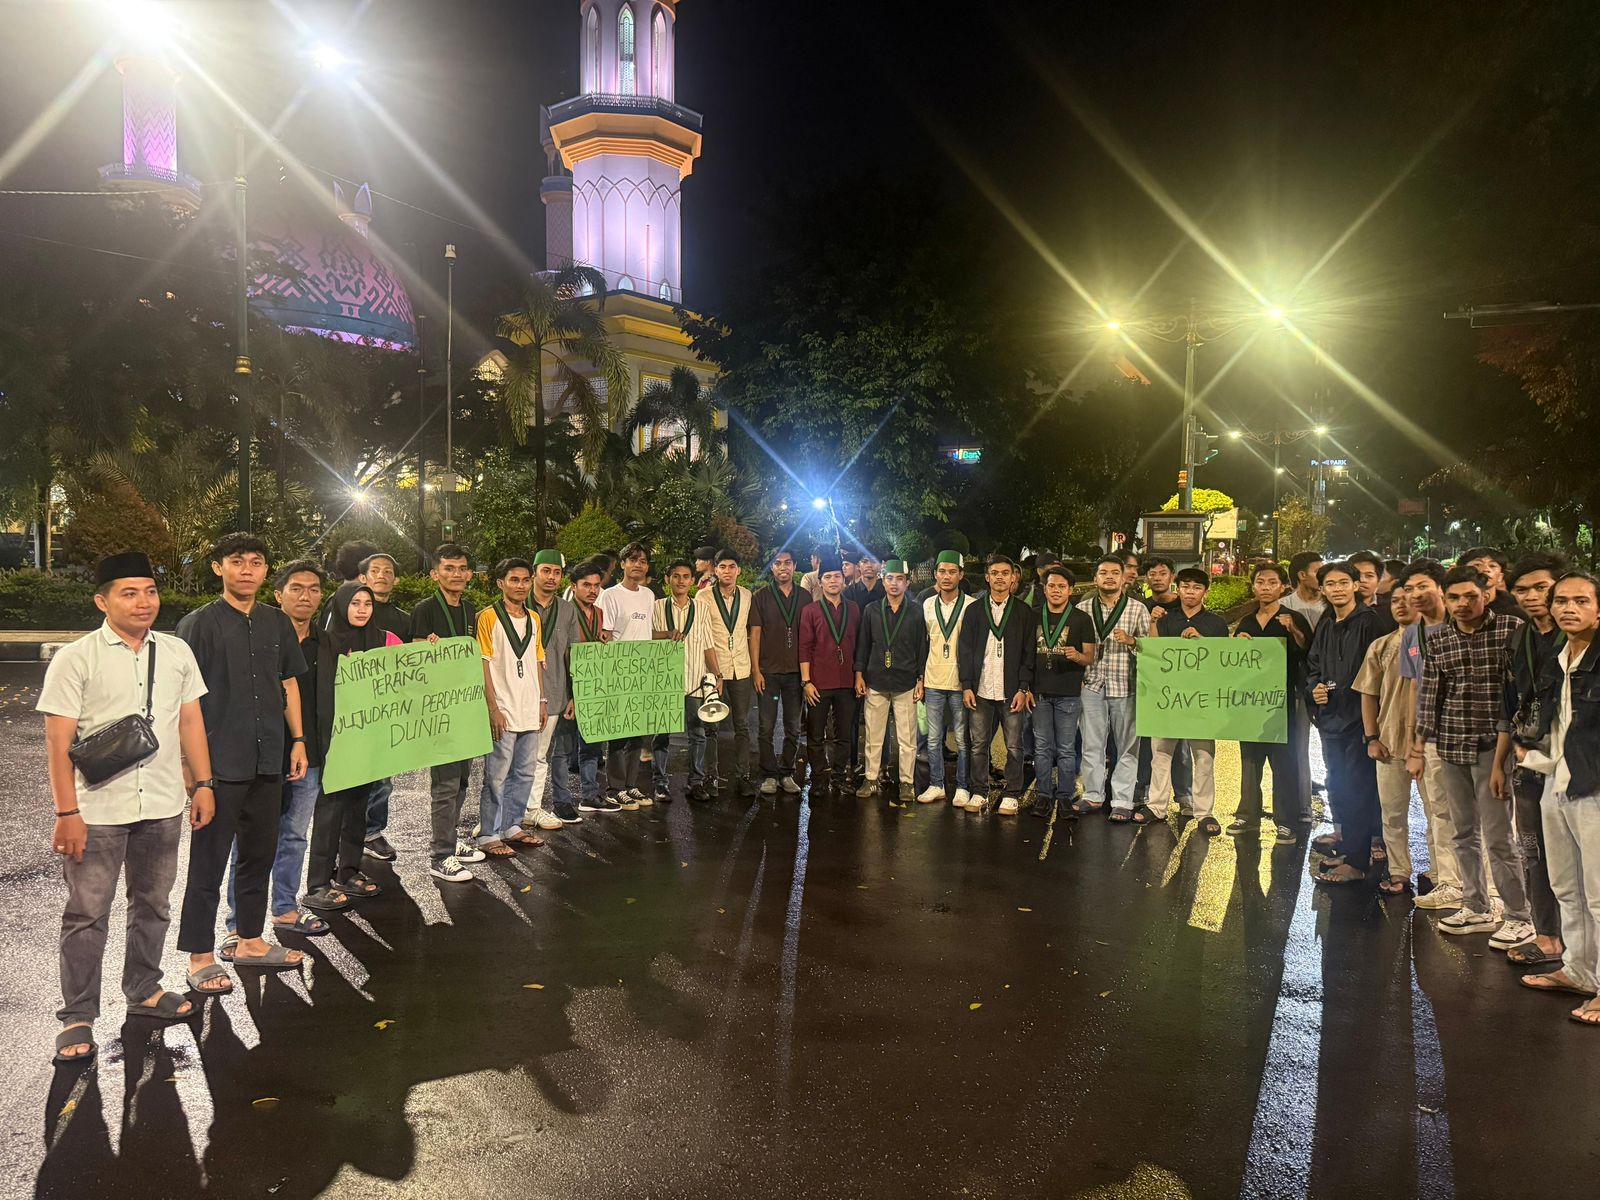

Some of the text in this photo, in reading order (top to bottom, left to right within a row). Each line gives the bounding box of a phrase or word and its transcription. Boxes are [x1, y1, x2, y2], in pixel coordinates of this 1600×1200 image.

[395, 641, 475, 670] KEJAHATAN
[575, 642, 641, 661] MENGUTUK
[1160, 646, 1263, 674] STOP WAR
[574, 657, 675, 678] KAN AS-ISRAEL
[371, 667, 429, 699] PERANG
[574, 674, 683, 697] TERHADAP IRAN
[577, 694, 684, 720] REZIM AS-ISRAEL
[1156, 685, 1209, 710] SAVE
[389, 713, 450, 749] DUNIA
[580, 711, 683, 737] PELANGGAR HAM
